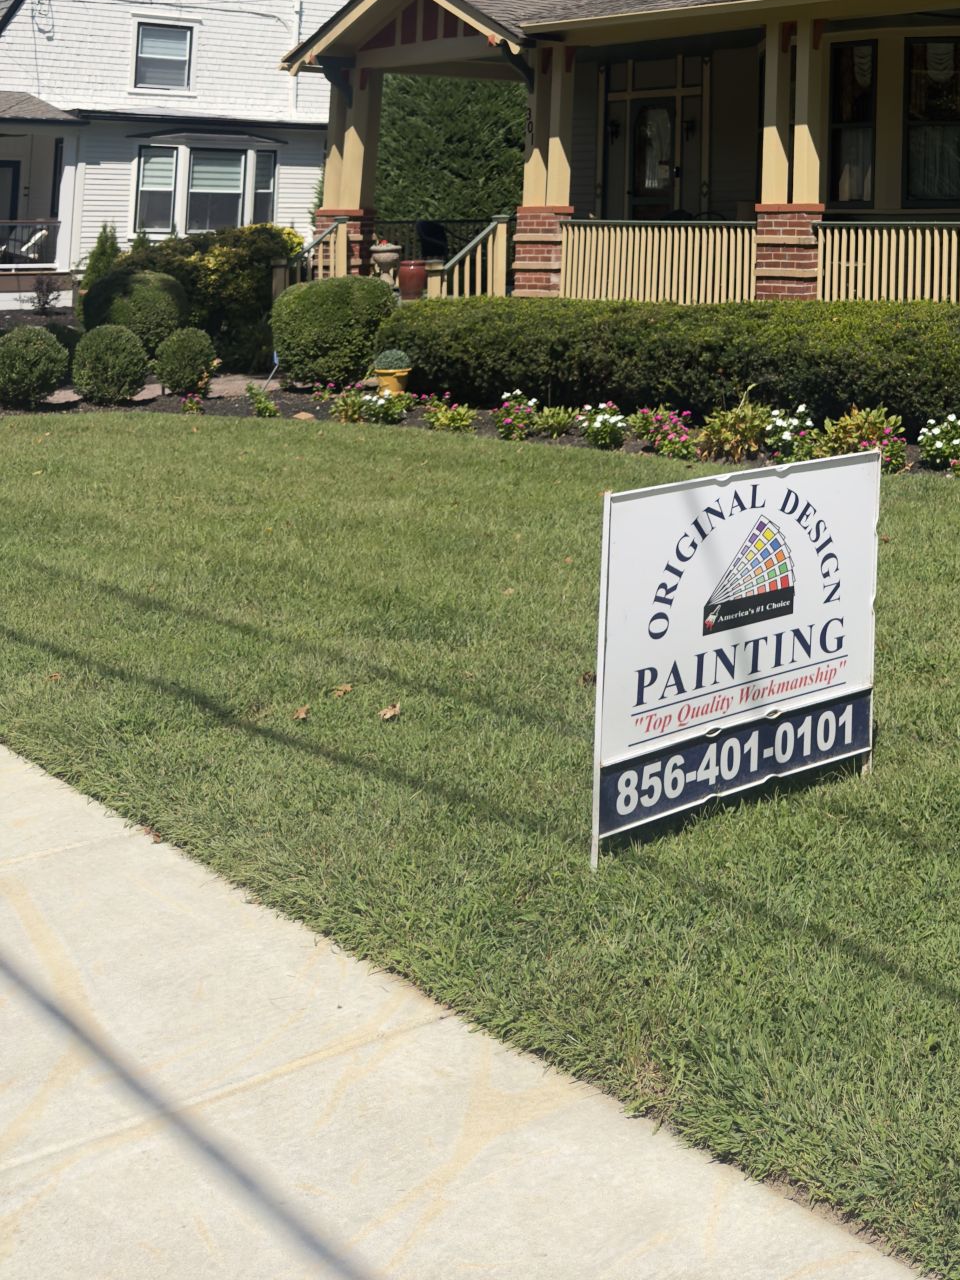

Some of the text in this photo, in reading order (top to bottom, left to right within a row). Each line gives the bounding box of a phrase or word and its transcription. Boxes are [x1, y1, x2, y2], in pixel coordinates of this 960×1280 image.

[648, 484, 841, 640] ORIGINAL DESIGN
[717, 600, 791, 623] America's #1 Choice
[632, 617, 847, 707] PAINTING
[634, 659, 847, 733] "Top Quality Workmanship"
[615, 704, 853, 816] 856-401-0101
